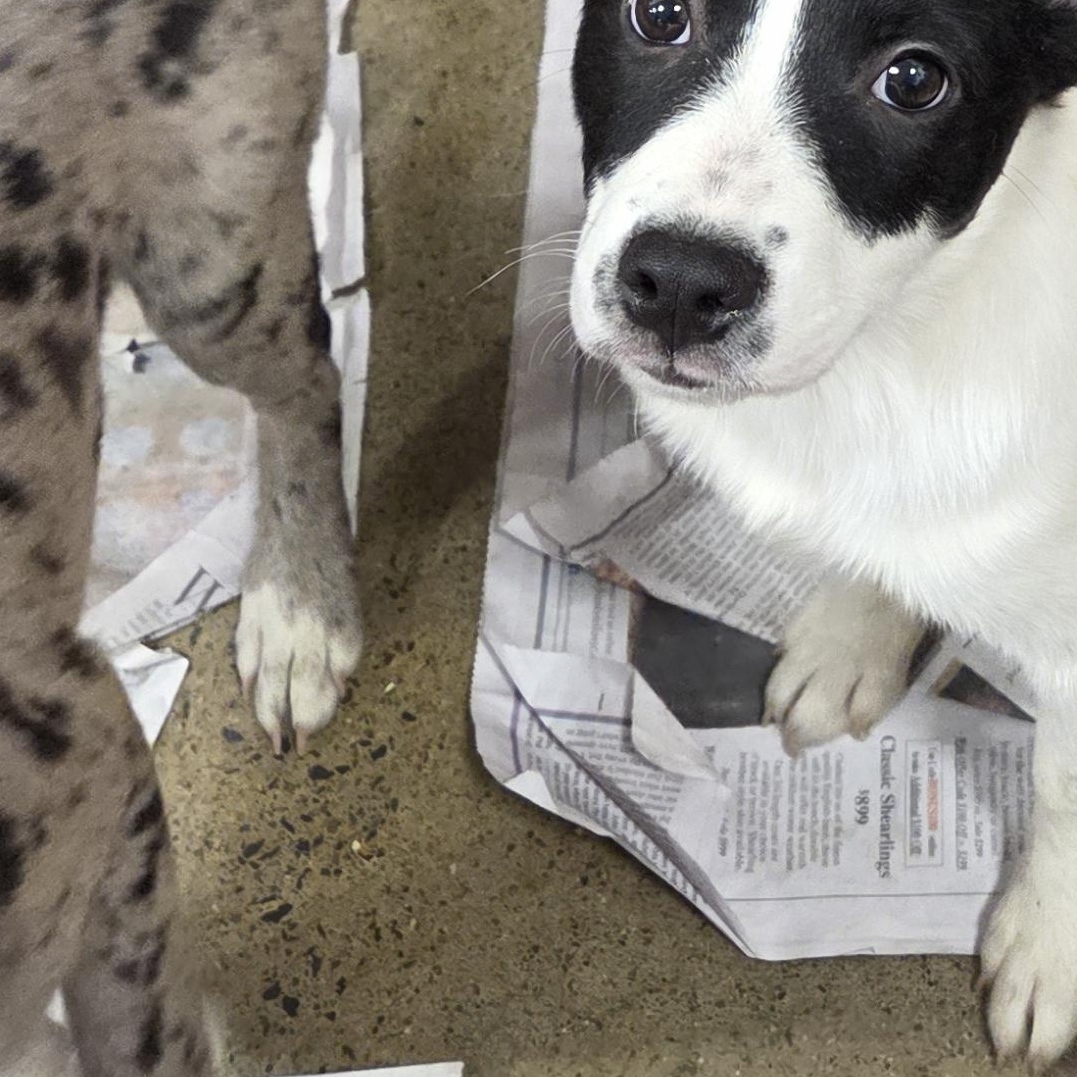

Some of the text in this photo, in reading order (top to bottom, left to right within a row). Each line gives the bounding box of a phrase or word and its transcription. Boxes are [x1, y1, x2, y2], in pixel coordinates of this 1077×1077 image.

[854, 789, 869, 824] $899
[875, 734, 896, 879] Classic Shearlings
